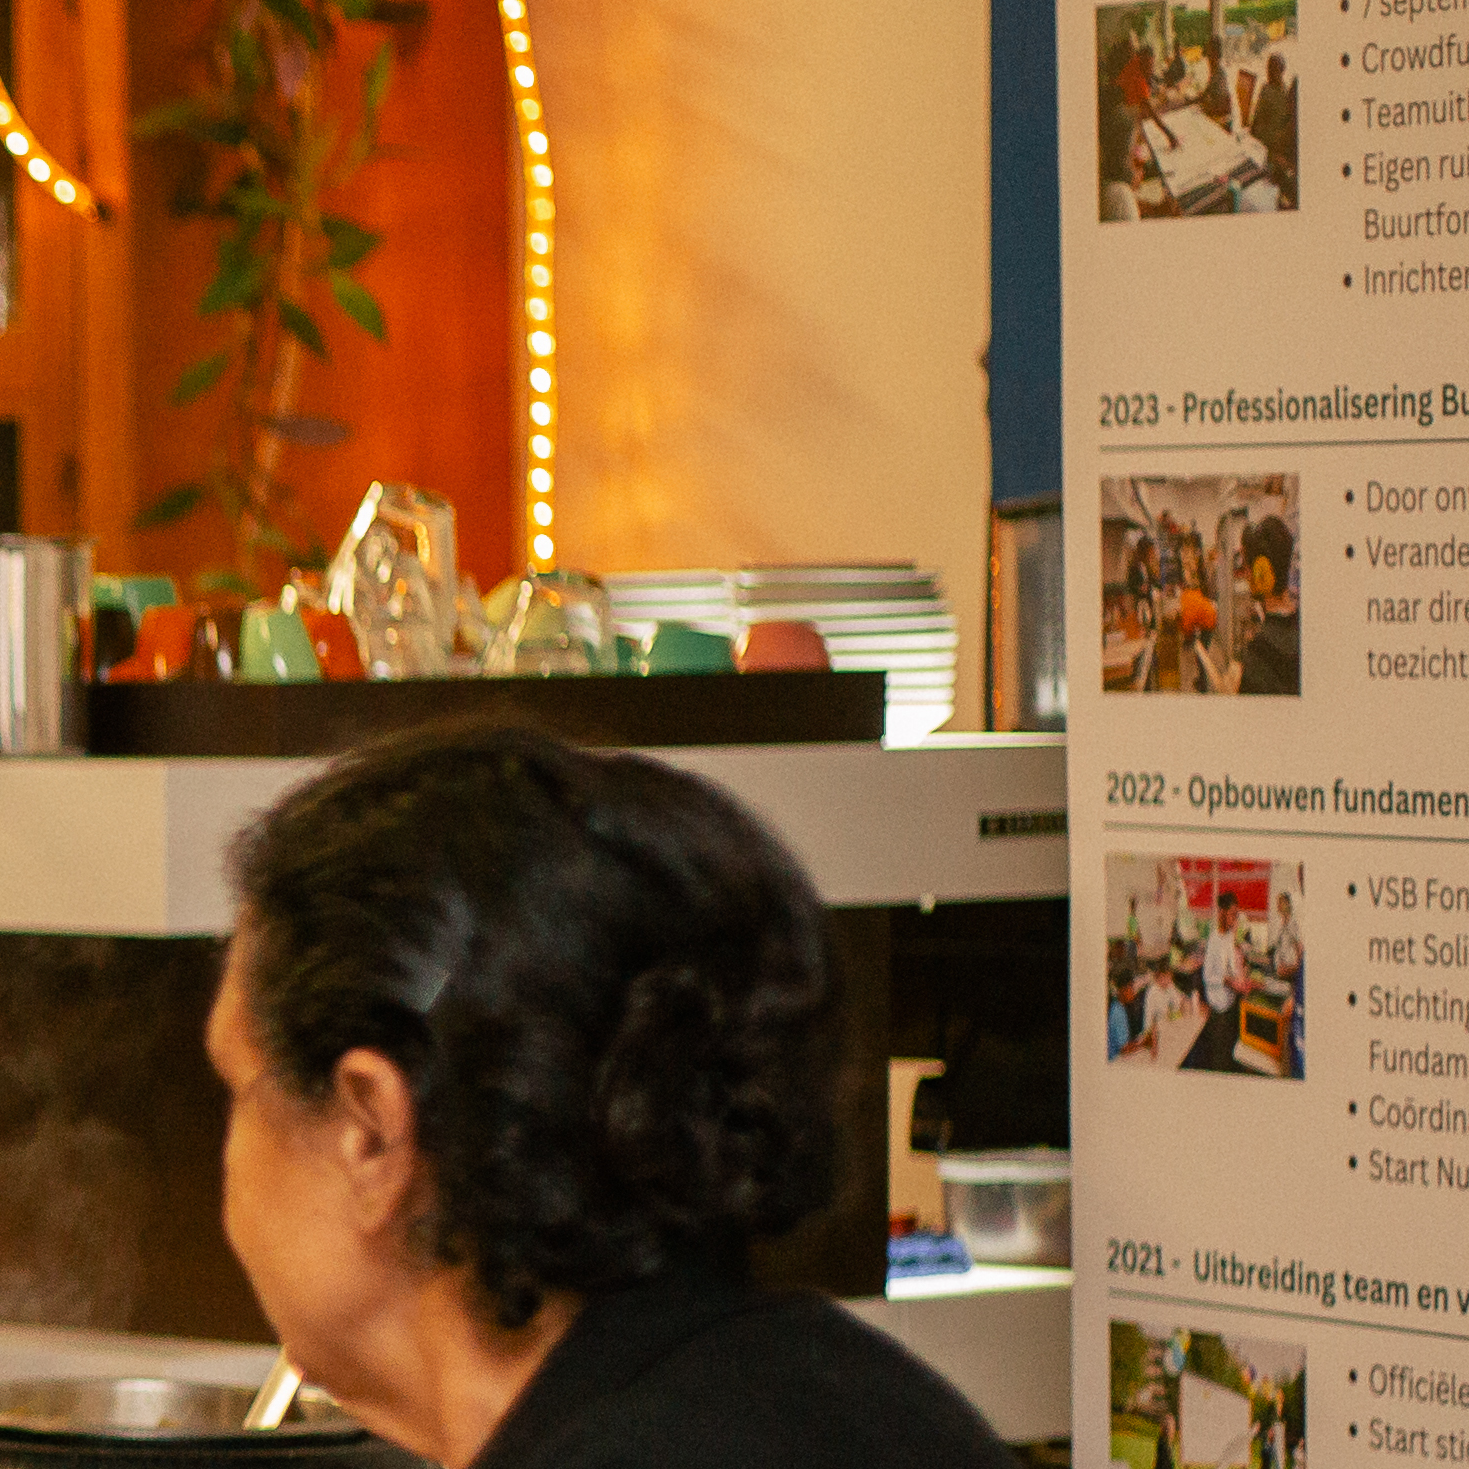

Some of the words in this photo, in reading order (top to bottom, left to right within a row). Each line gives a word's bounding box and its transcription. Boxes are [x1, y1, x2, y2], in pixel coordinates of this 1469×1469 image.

[1362, 33, 1469, 74] Crowdfu
[1361, 88, 1469, 129] Teamuit
[1364, 152, 1430, 192] Eigen
[1099, 393, 1160, 428] 2023
[1182, 382, 1434, 427] Professionalisering
[1367, 480, 1428, 513] Door
[1436, 486, 1469, 512] on
[1366, 534, 1469, 568] Verande
[1367, 597, 1420, 623] naar
[1368, 645, 1469, 678] toezicht
[1106, 772, 1166, 806] 2022
[1188, 775, 1325, 816] Opbouwen
[1333, 778, 1469, 817] fundamen
[1368, 875, 1417, 910] VSB
[1369, 935, 1416, 966] met
[1369, 1039, 1469, 1077] Fundam
[1369, 1094, 1469, 1133] Coördin
[1369, 1149, 1429, 1187] Start
[1108, 1239, 1166, 1277] 2021
[1193, 1250, 1336, 1307] Uitbreiding
[1343, 1271, 1410, 1308] team
[1418, 1284, 1449, 1312] en
[1369, 1417, 1428, 1457] Start
